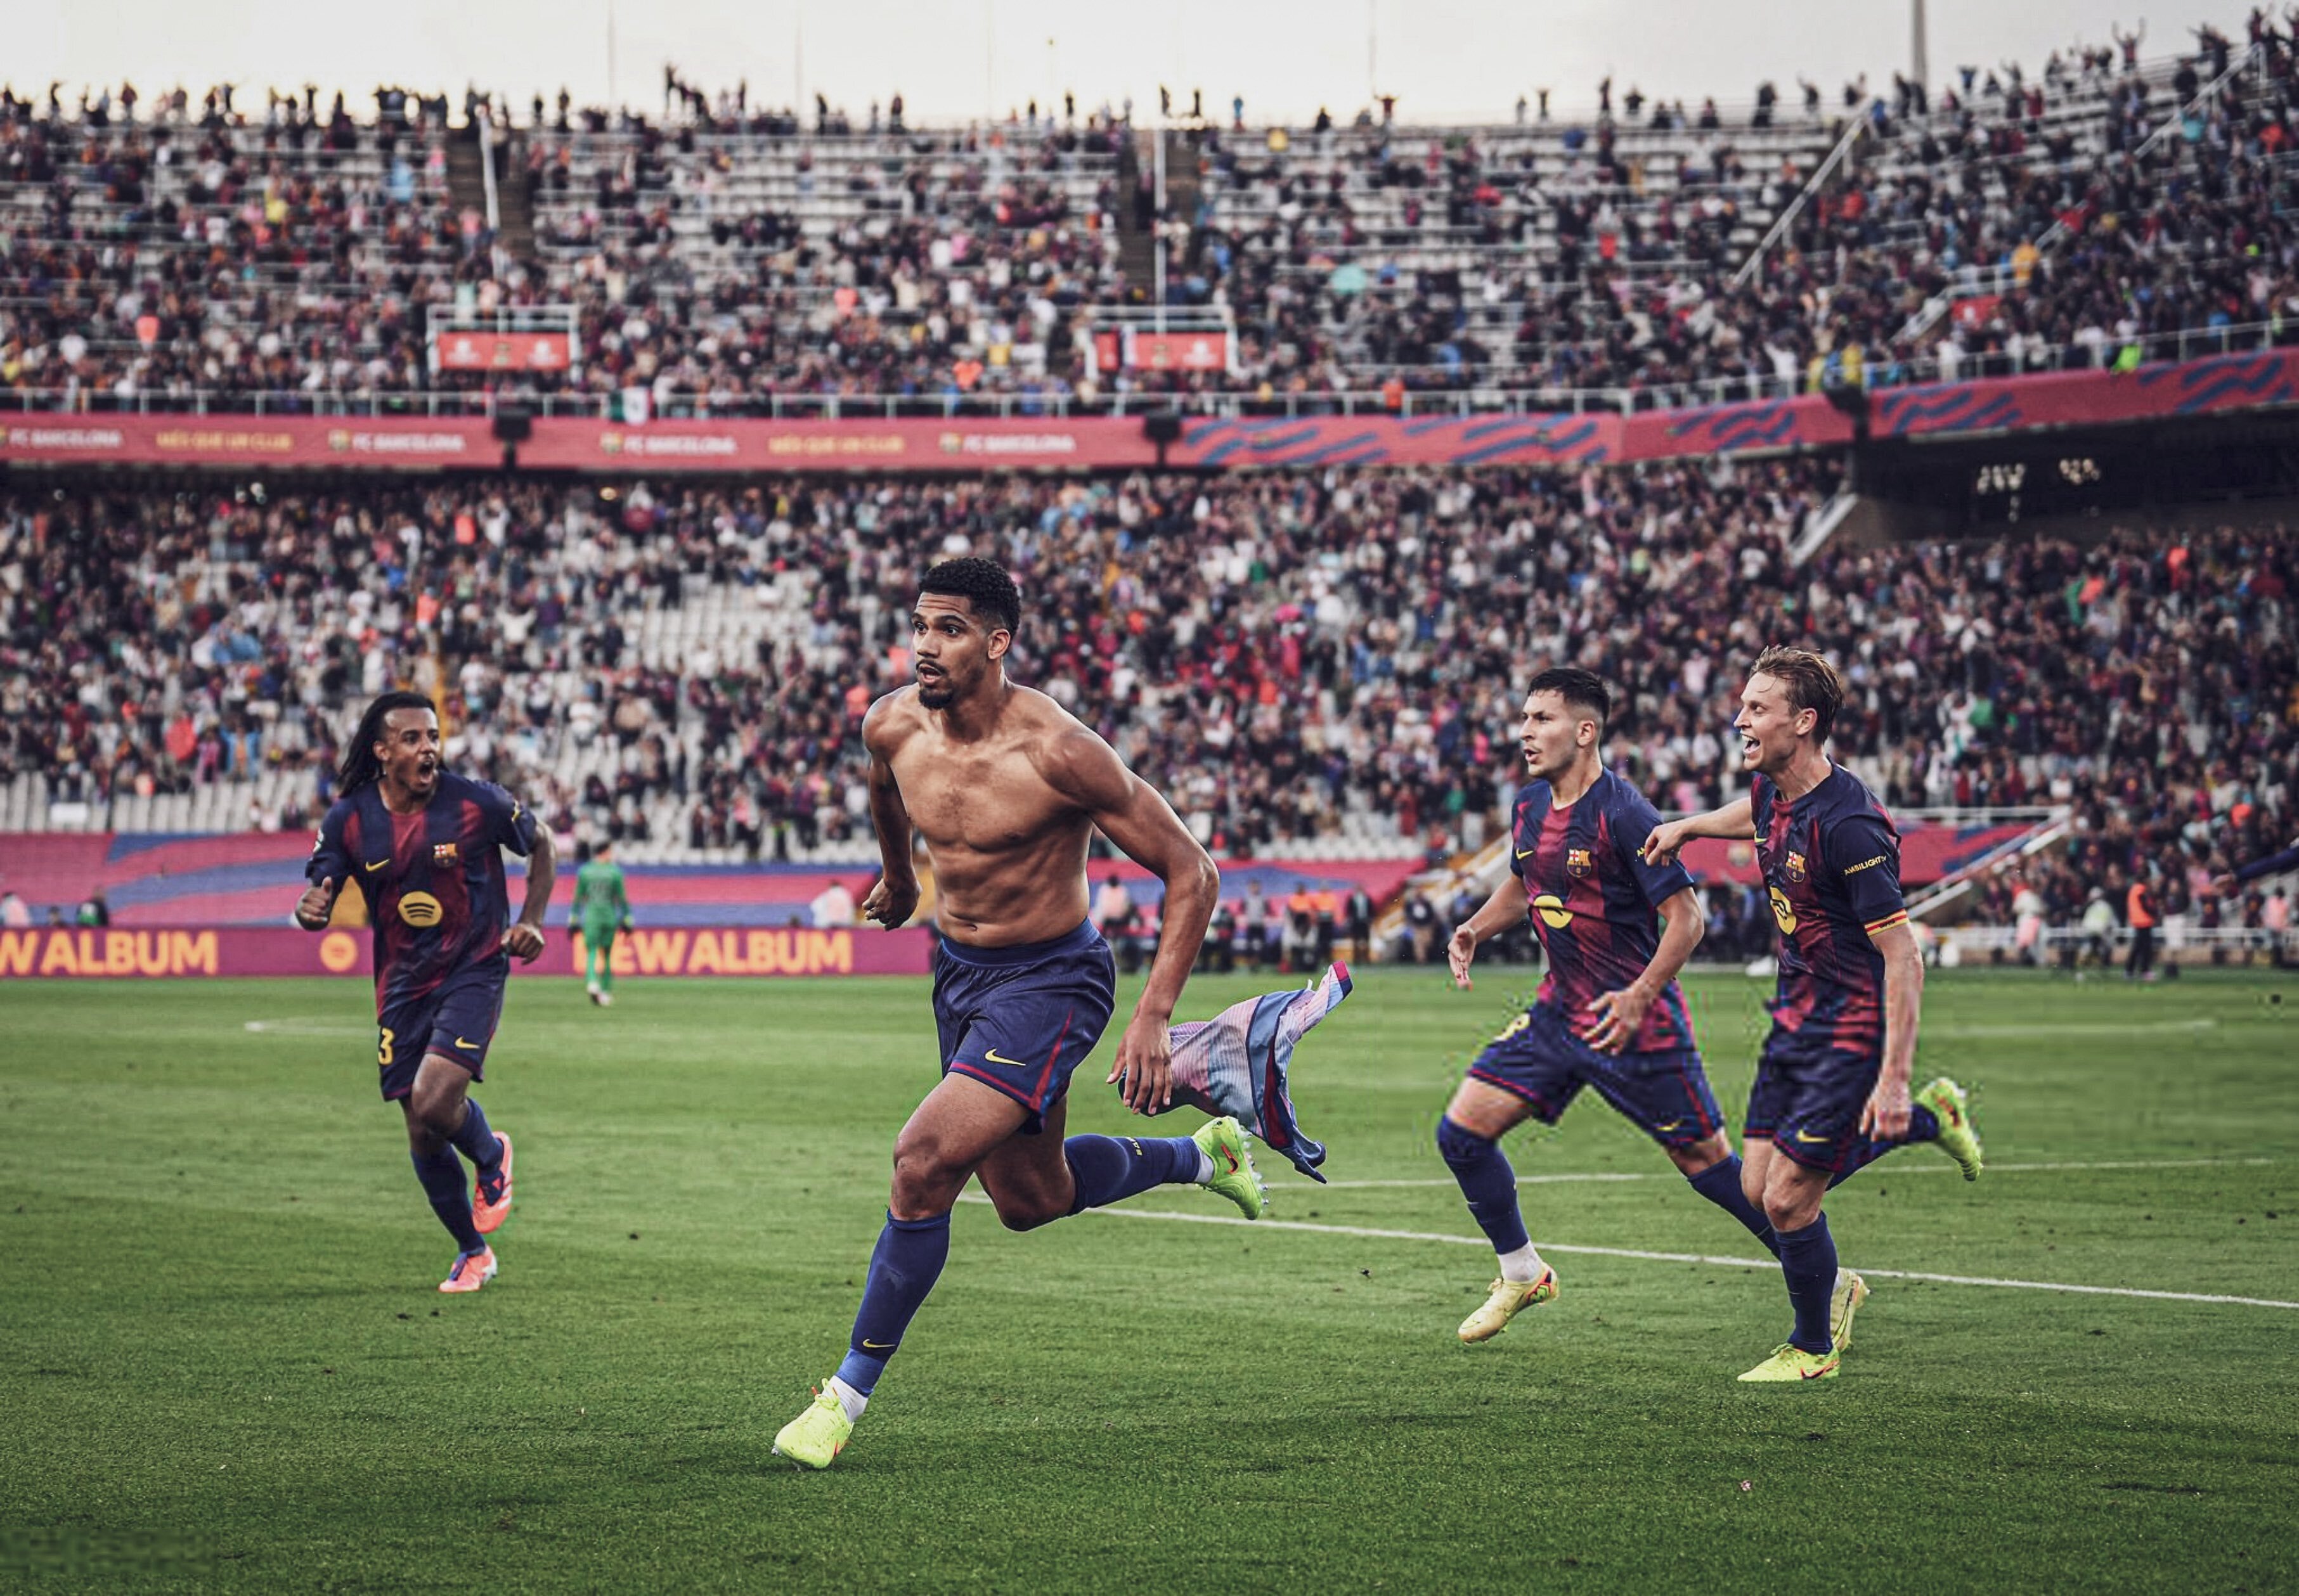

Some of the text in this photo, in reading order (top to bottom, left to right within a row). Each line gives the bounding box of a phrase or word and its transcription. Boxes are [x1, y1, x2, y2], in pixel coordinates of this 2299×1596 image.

[40, 931, 218, 975] ALBUM
[687, 930, 853, 974] ALBUM
[378, 1027, 394, 1065] 3
